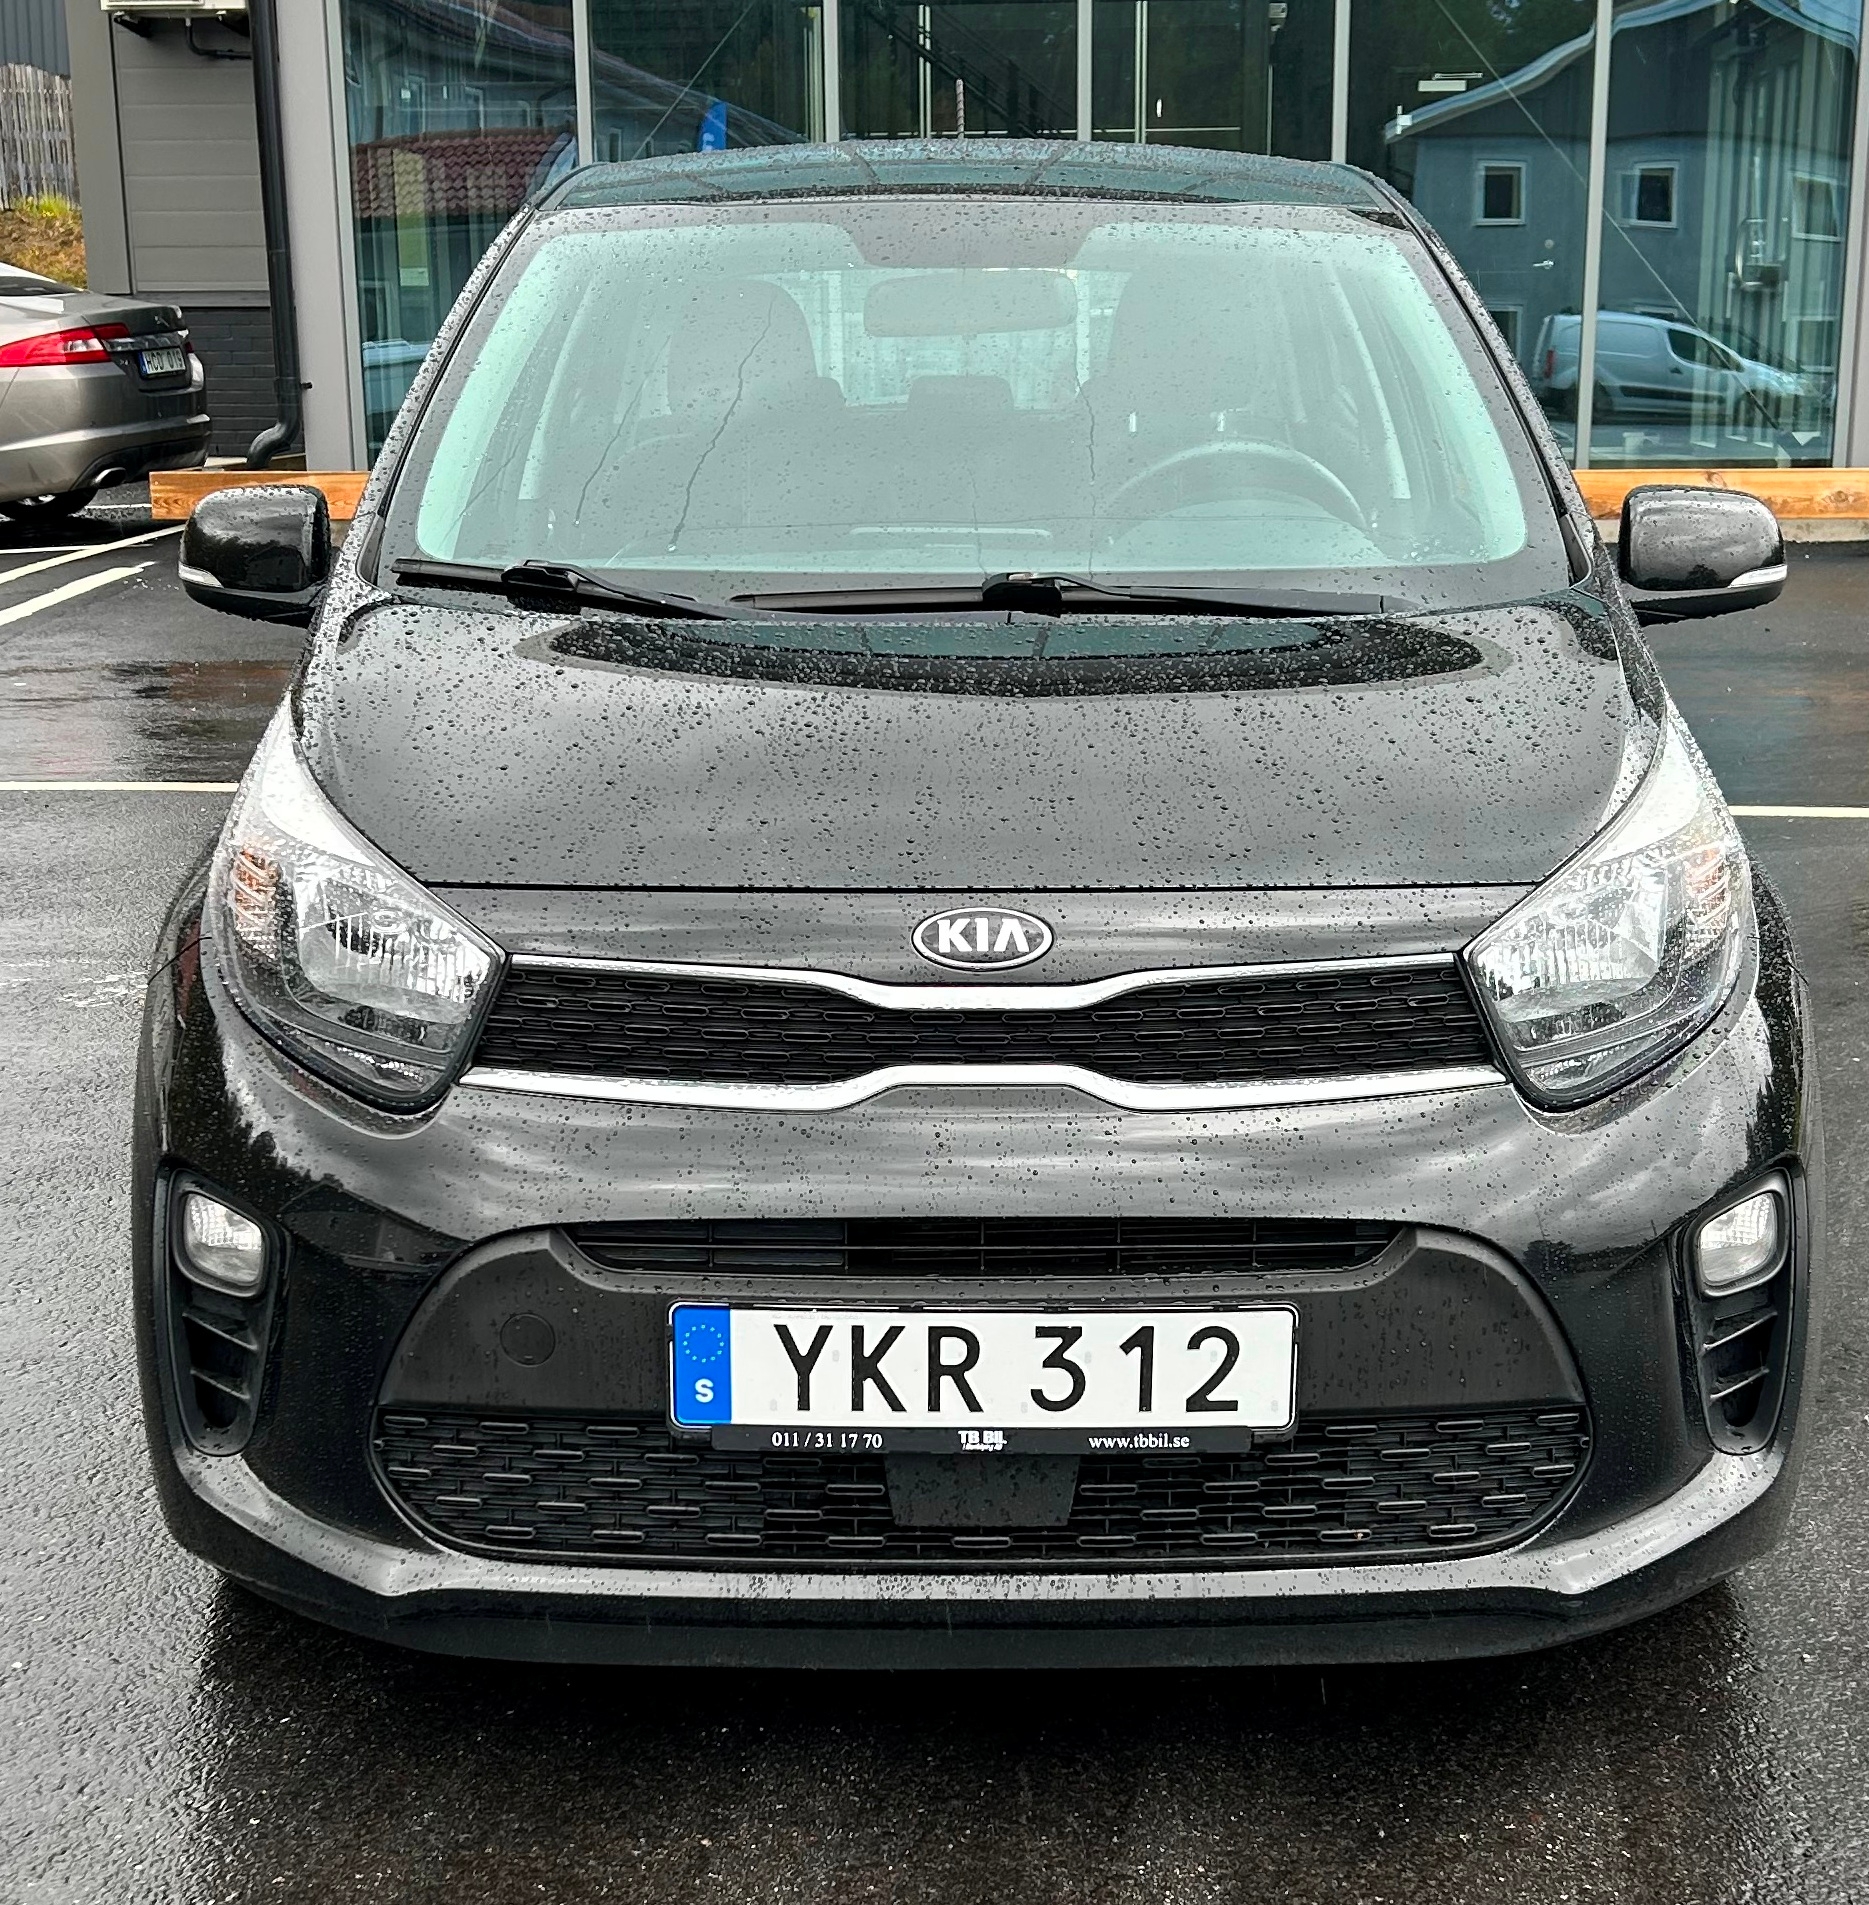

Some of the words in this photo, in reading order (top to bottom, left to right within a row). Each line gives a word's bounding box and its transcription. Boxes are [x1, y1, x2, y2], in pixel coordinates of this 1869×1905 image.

[936, 917, 1030, 954] KIA
[773, 1323, 985, 1413] YKR
[1030, 1325, 1241, 1413] 312
[694, 1378, 714, 1404] S
[771, 1431, 799, 1447] 011
[814, 1432, 833, 1448] 31
[841, 1432, 858, 1449] 17
[862, 1433, 883, 1449] 70
[957, 1430, 980, 1444] TB
[1088, 1432, 1190, 1449] www.tbbil.se
